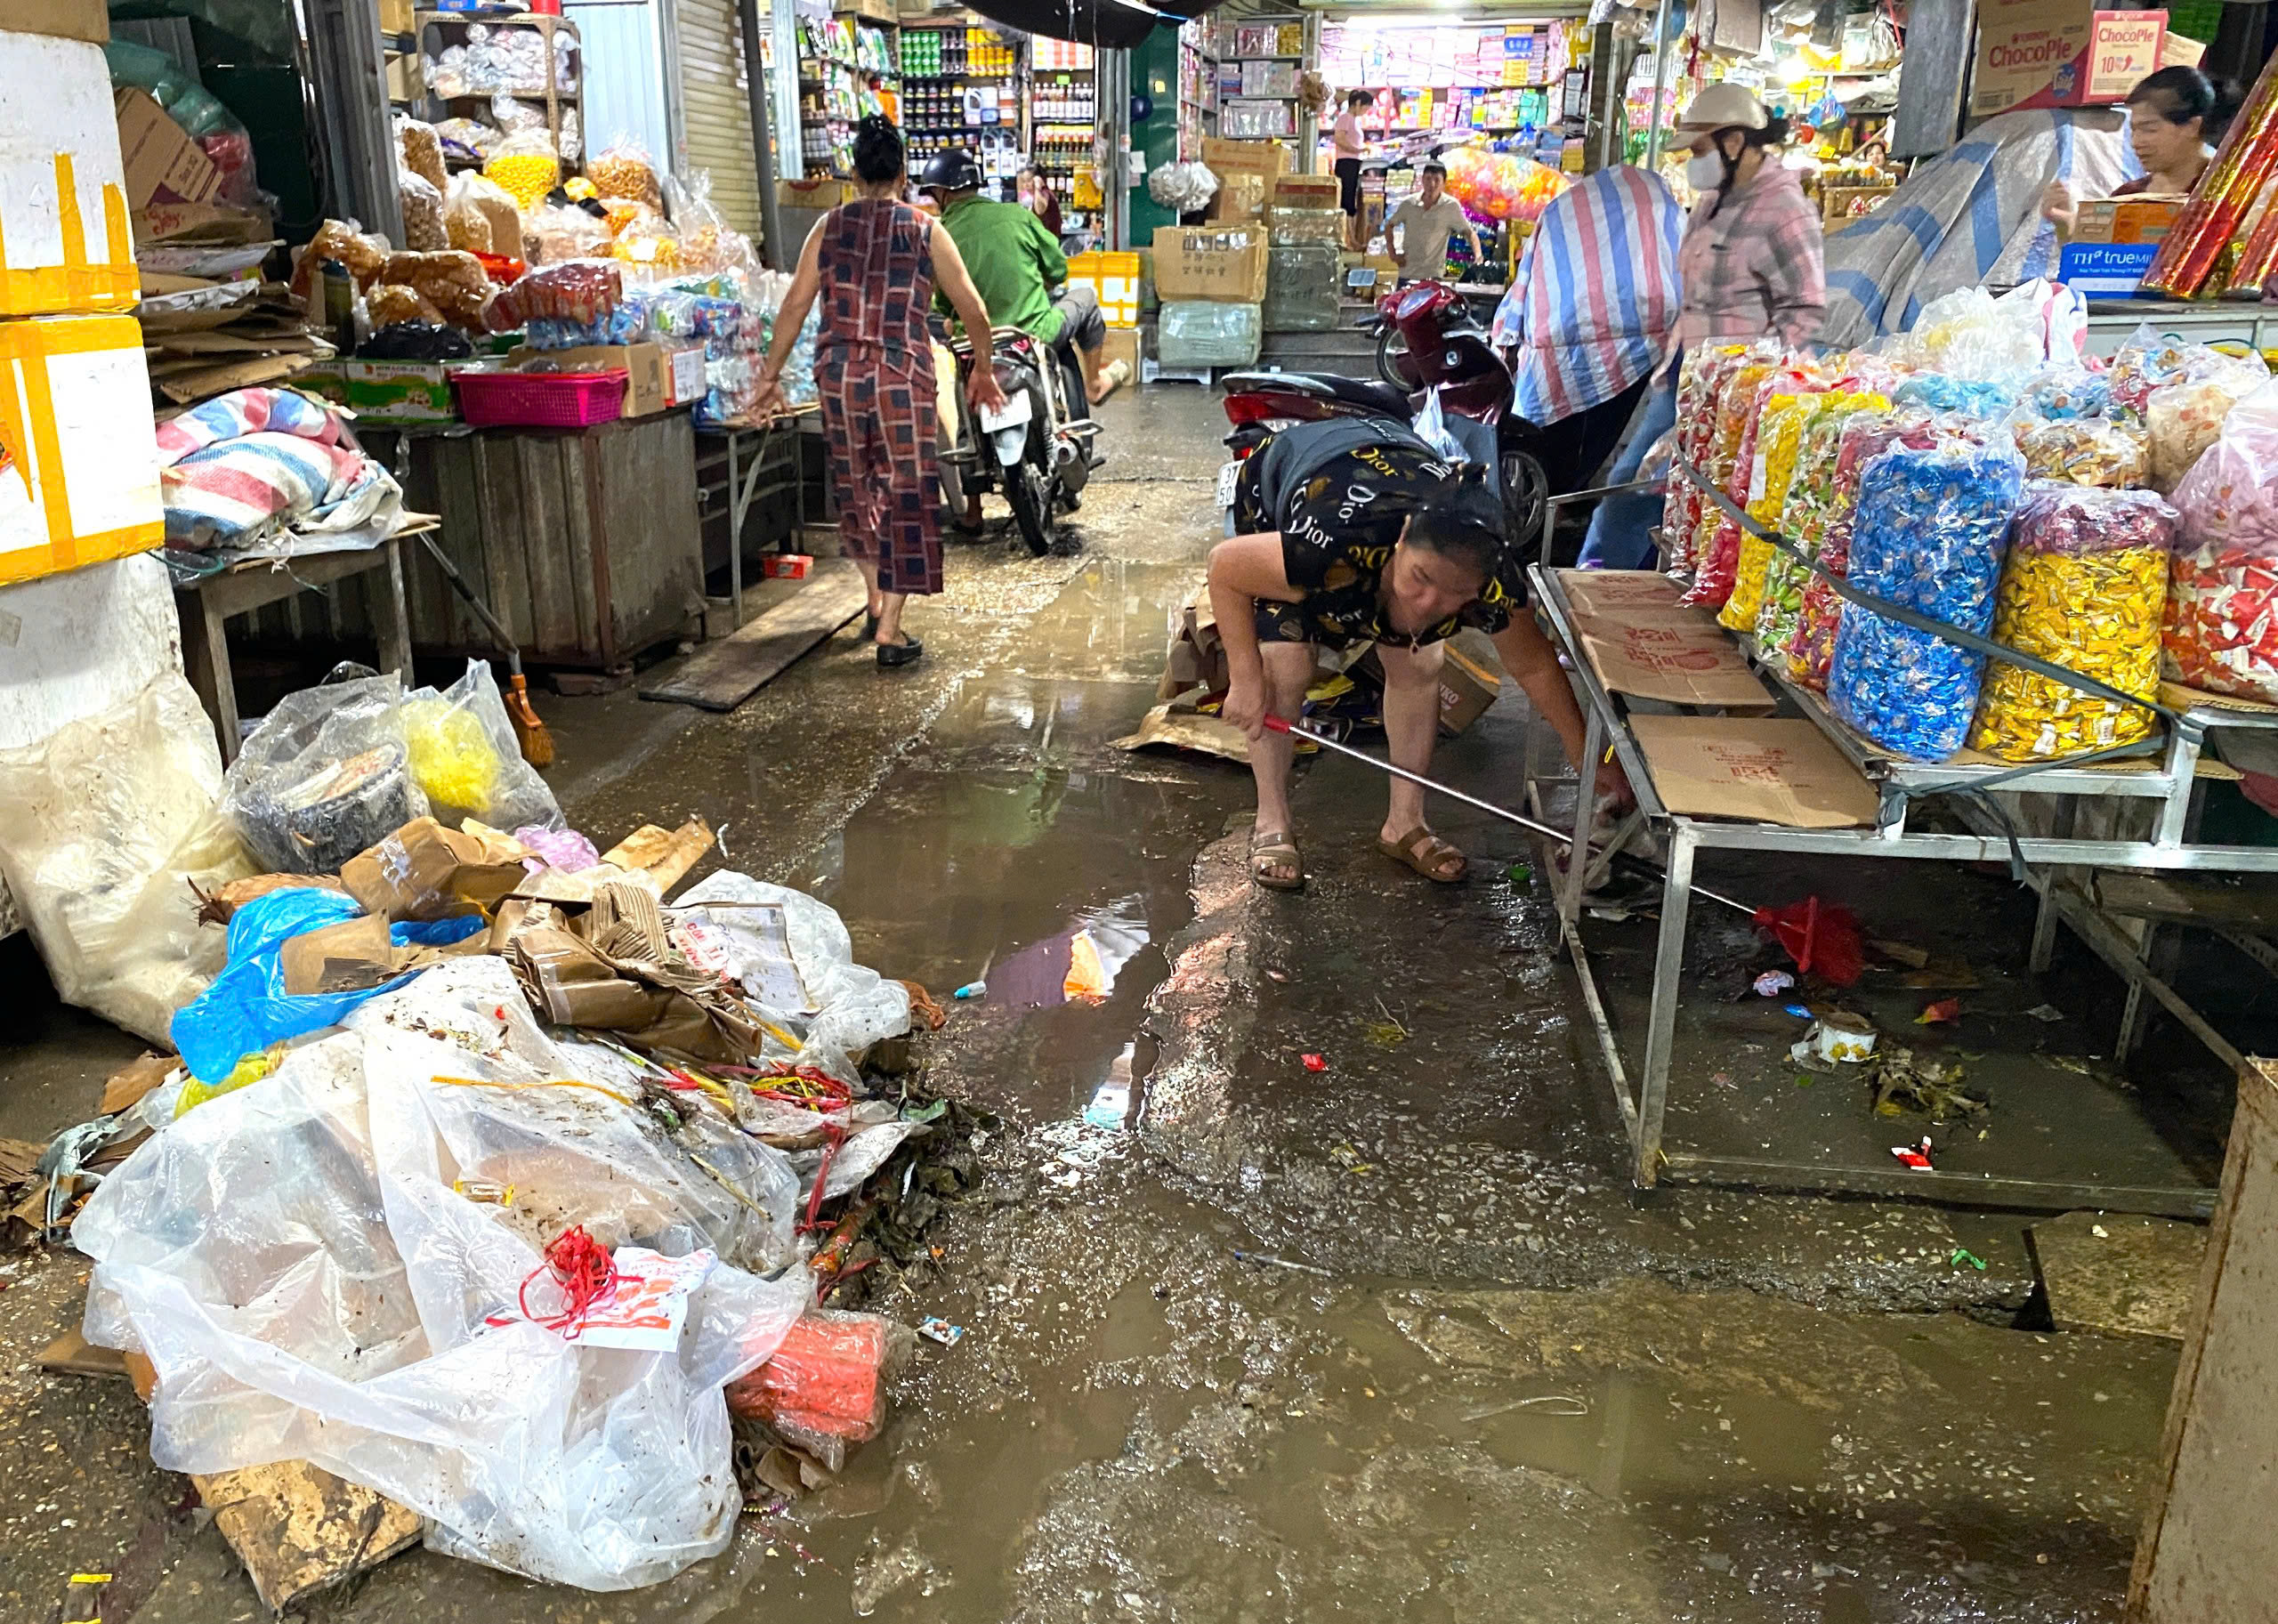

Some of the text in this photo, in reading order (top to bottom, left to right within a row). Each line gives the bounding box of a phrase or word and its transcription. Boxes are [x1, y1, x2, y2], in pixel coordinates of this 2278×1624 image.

[2099, 28, 2154, 43] ChocoPie
[1989, 36, 2072, 68] ChocoPie
[1350, 448, 1399, 477] Dior
[1284, 515, 1333, 549] Dior
